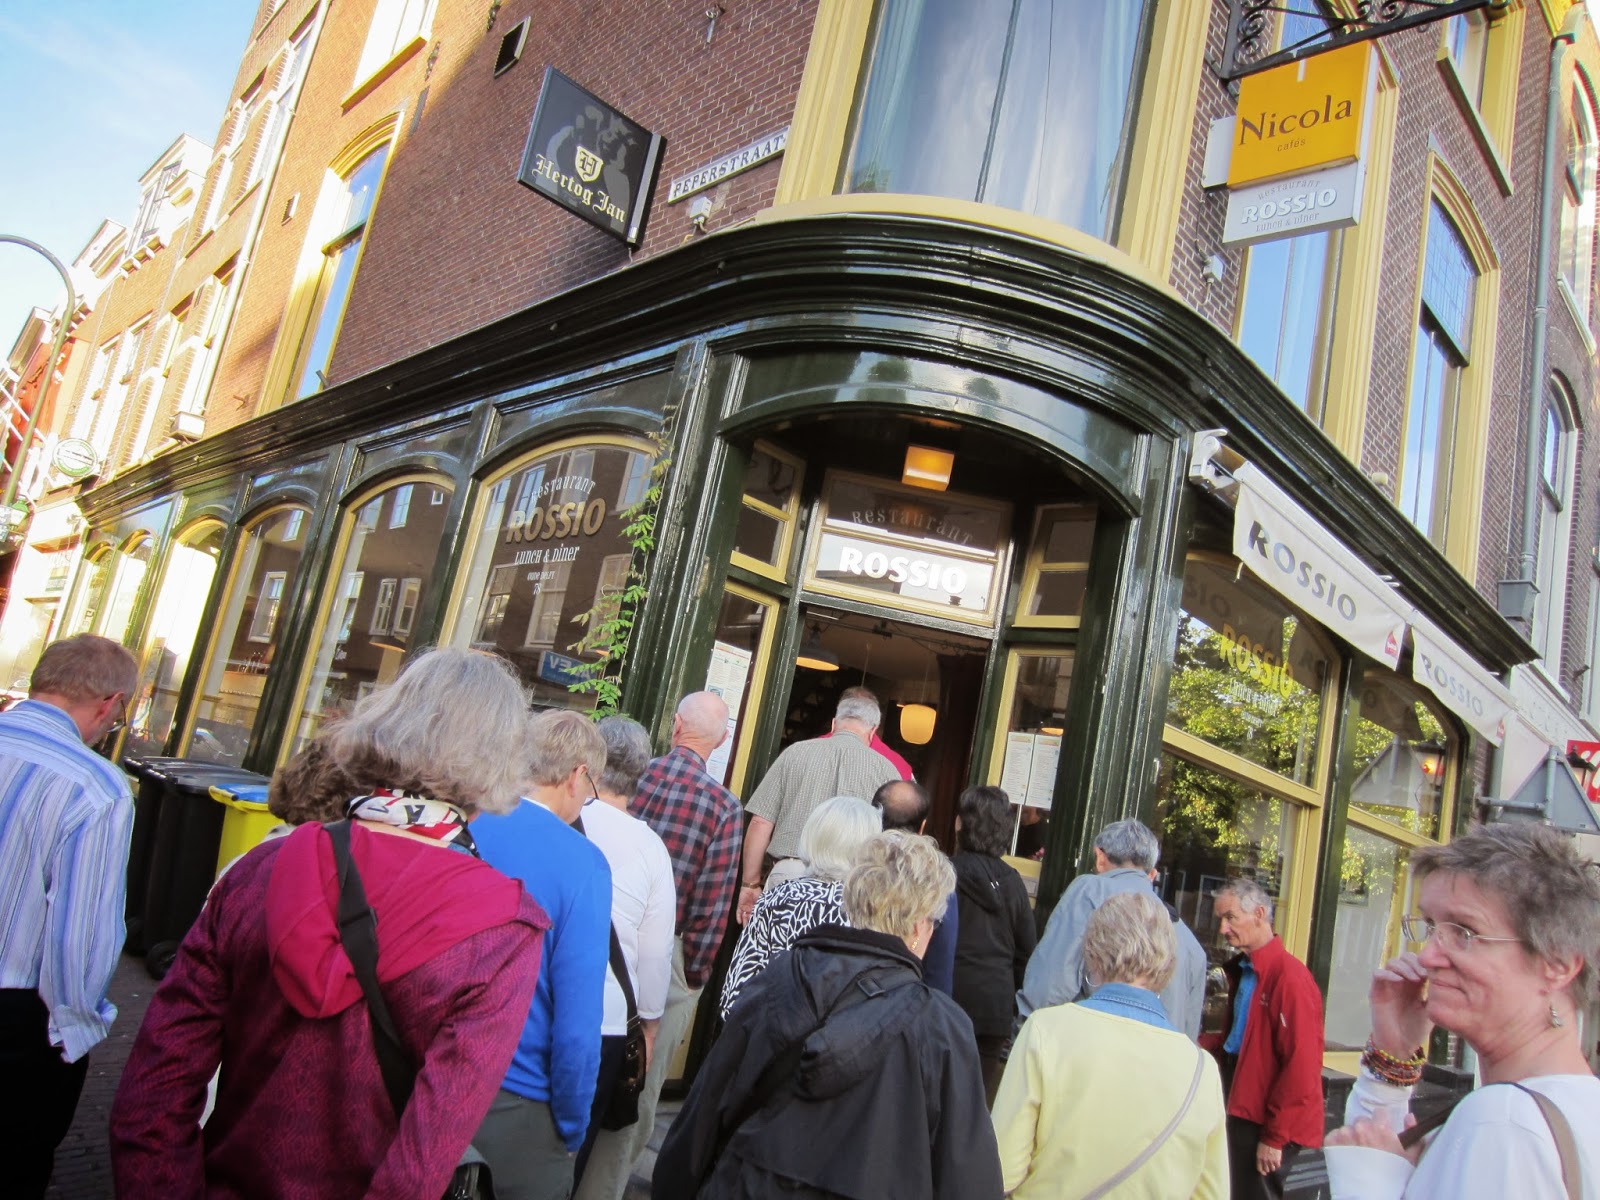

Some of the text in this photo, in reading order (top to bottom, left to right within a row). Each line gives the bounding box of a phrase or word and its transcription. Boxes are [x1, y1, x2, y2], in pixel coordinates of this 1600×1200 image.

[1239, 95, 1352, 146] Nicola
[1277, 137, 1306, 153] cafés
[531, 153, 626, 223] Hertog Jan
[673, 140, 783, 197] PEPERSTRAAT
[1241, 188, 1338, 225] ROSSIO
[505, 498, 606, 543] ROSSIO
[543, 548, 550, 563] &
[838, 546, 968, 595] ROSSIO
[1247, 520, 1358, 622] ROSSIO
[1219, 622, 1294, 700] ROSSIO
[1420, 652, 1484, 718] ROSSIO
